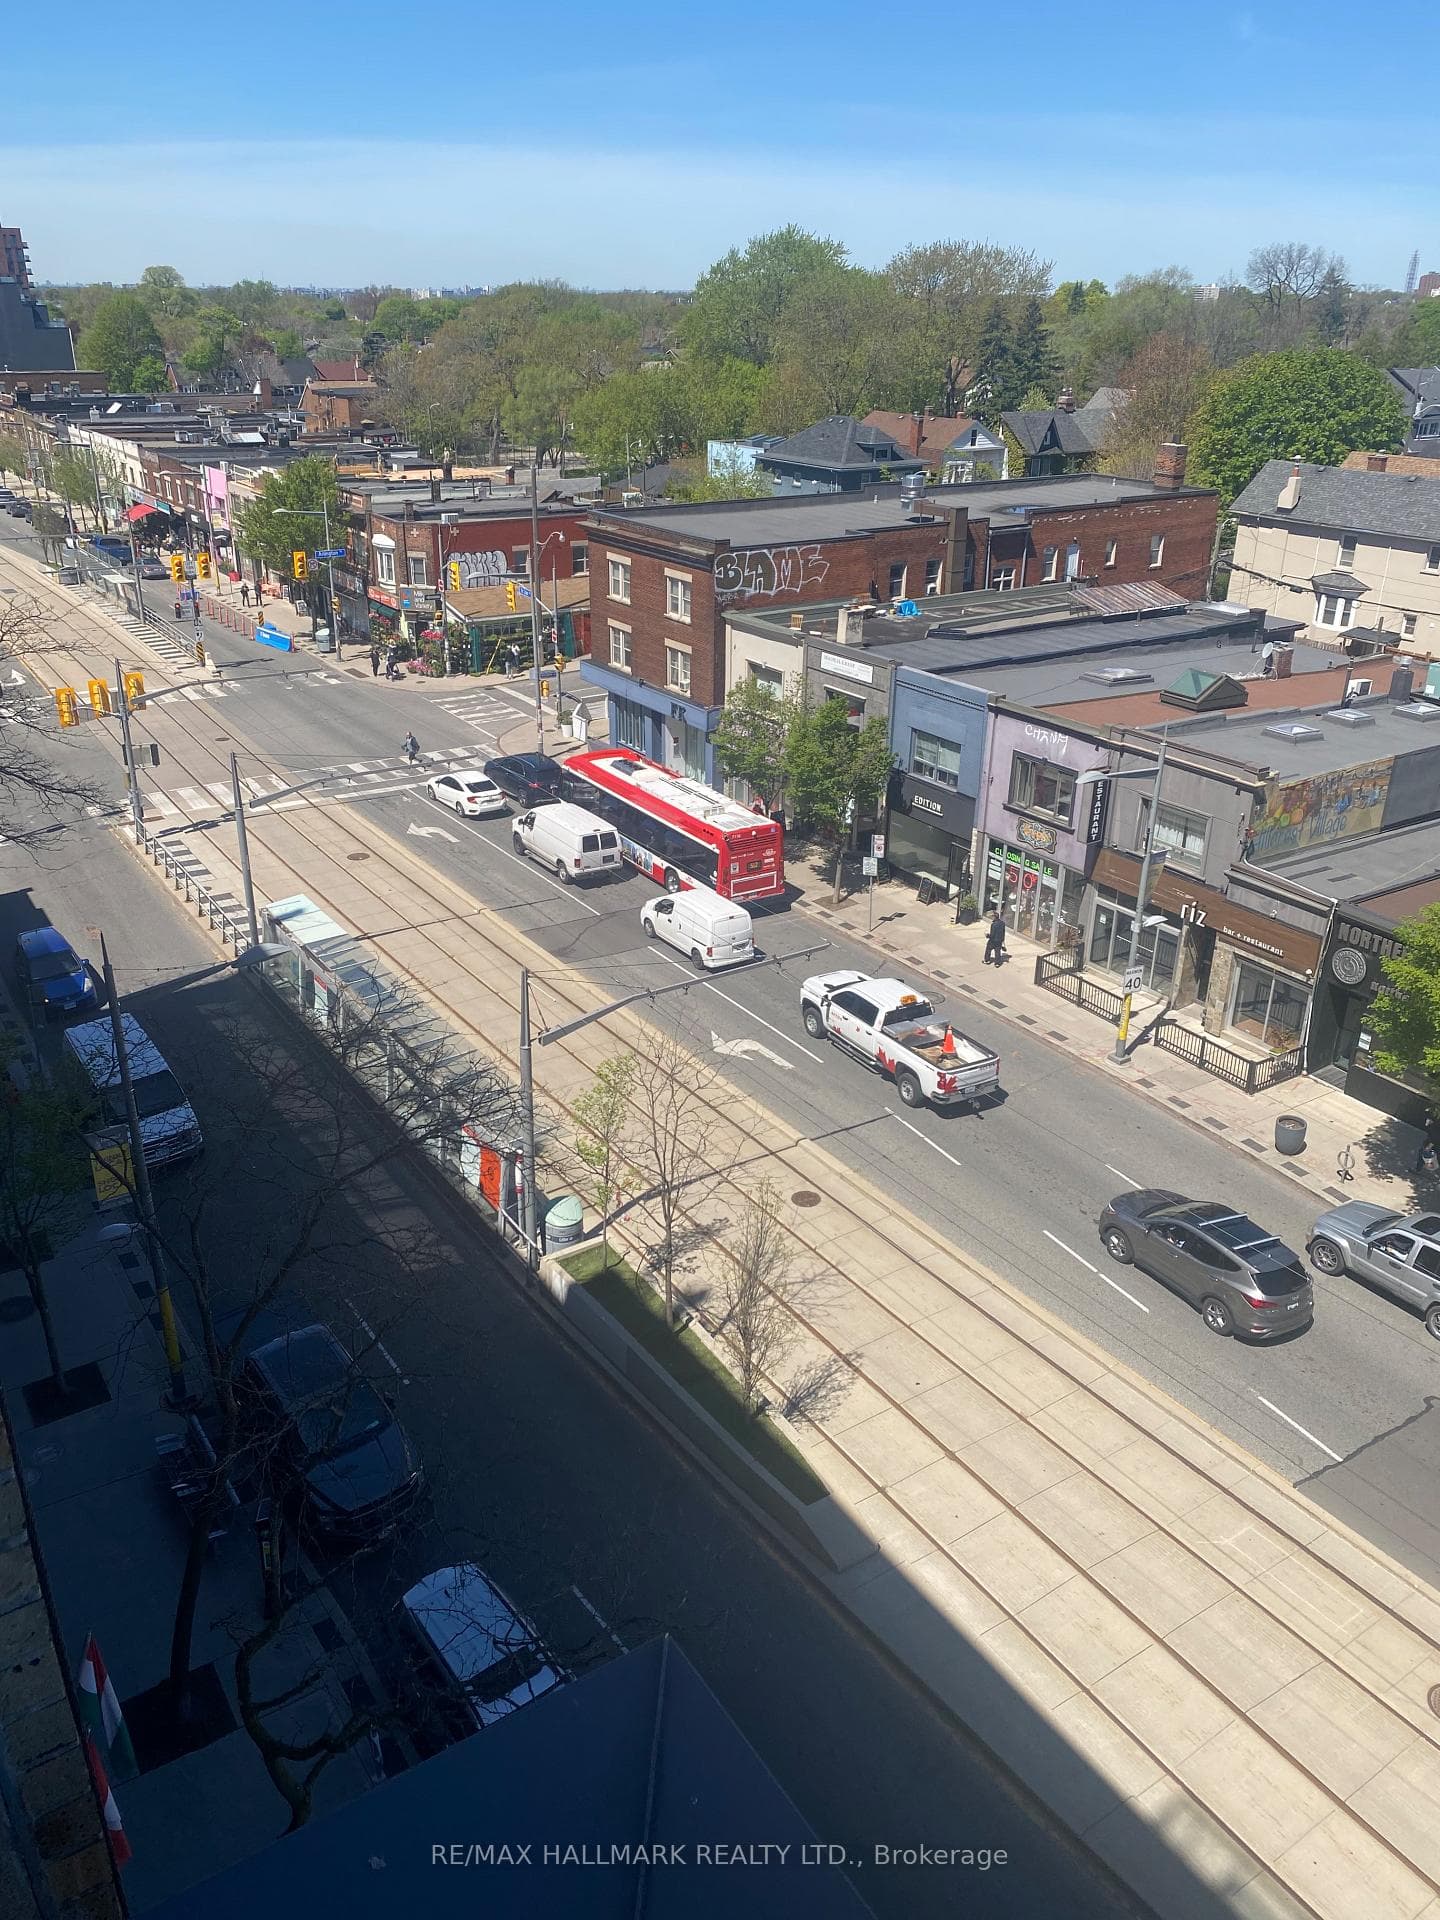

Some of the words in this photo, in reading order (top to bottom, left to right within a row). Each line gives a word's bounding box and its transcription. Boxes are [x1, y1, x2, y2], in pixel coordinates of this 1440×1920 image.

[914, 795, 942, 812] EDITION
[1309, 810, 1347, 840] Village
[1180, 901, 1207, 928] riz
[1223, 926, 1235, 937] bar
[1243, 934, 1284, 957] restaurant
[1125, 976, 1141, 990] 40
